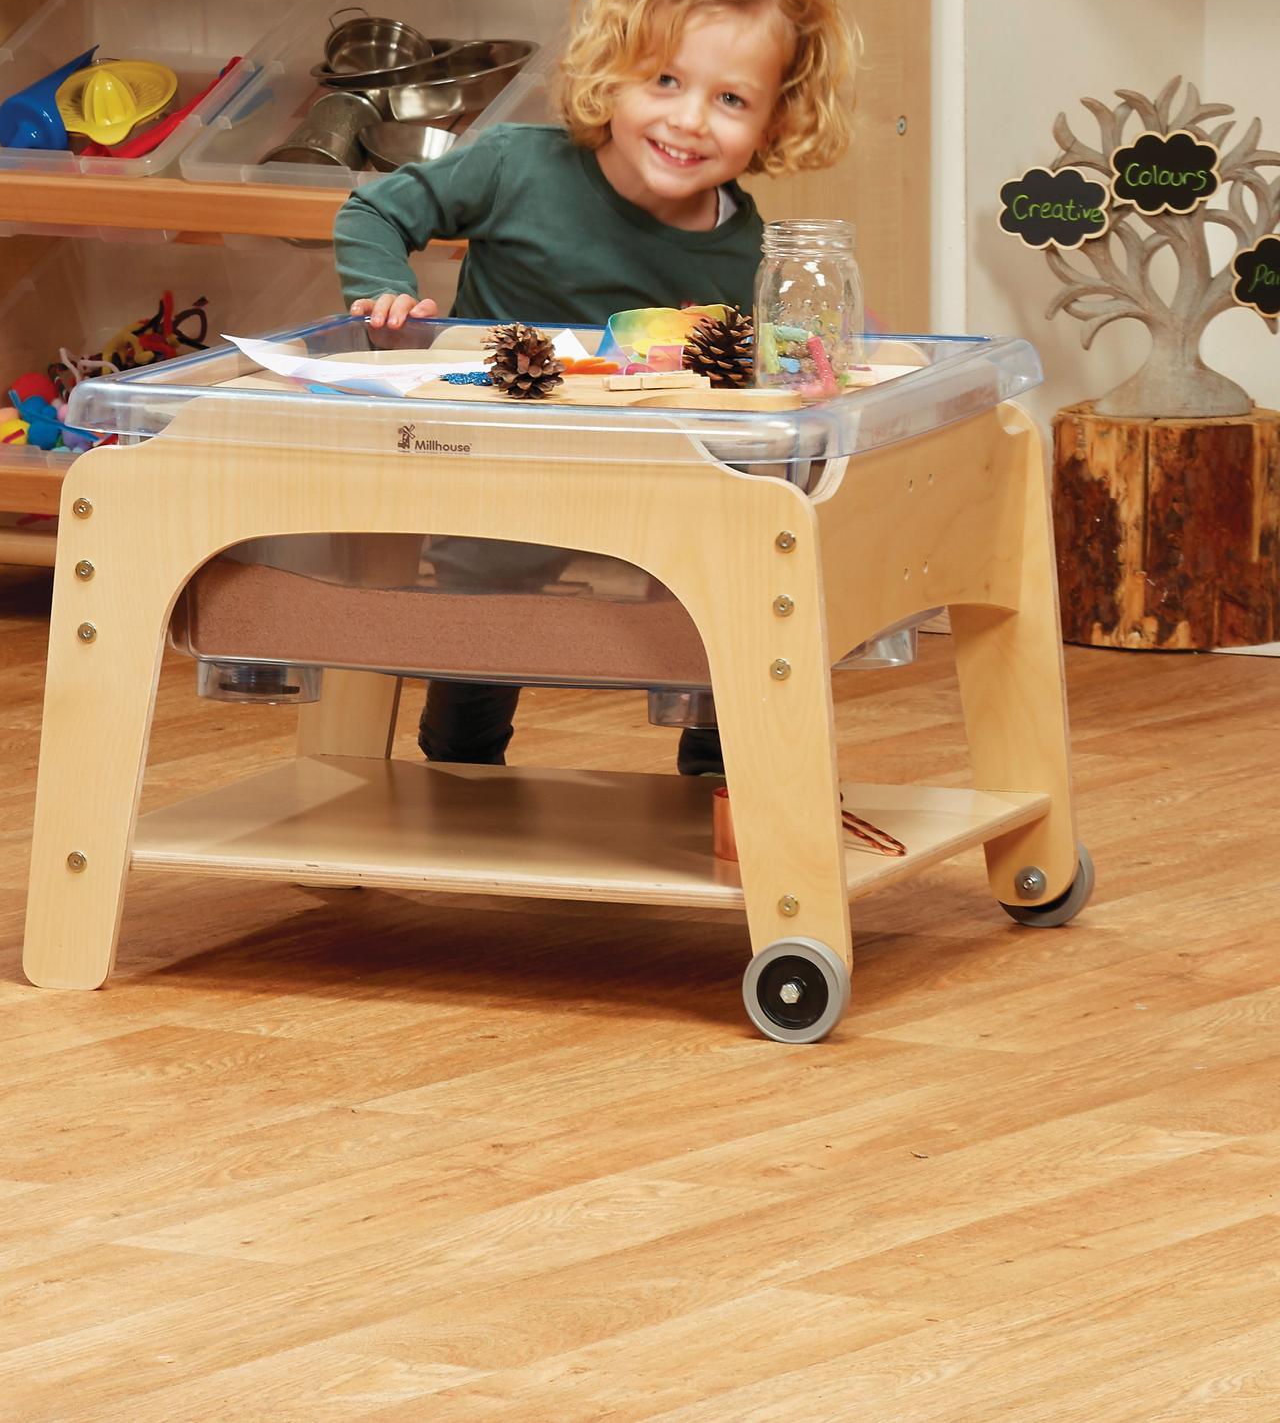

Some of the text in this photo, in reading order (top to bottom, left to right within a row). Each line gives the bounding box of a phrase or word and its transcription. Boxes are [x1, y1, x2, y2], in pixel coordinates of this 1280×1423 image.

[1125, 162, 1208, 191] Colours
[1012, 194, 1105, 223] Creative
[414, 440, 471, 453] Millhouse
